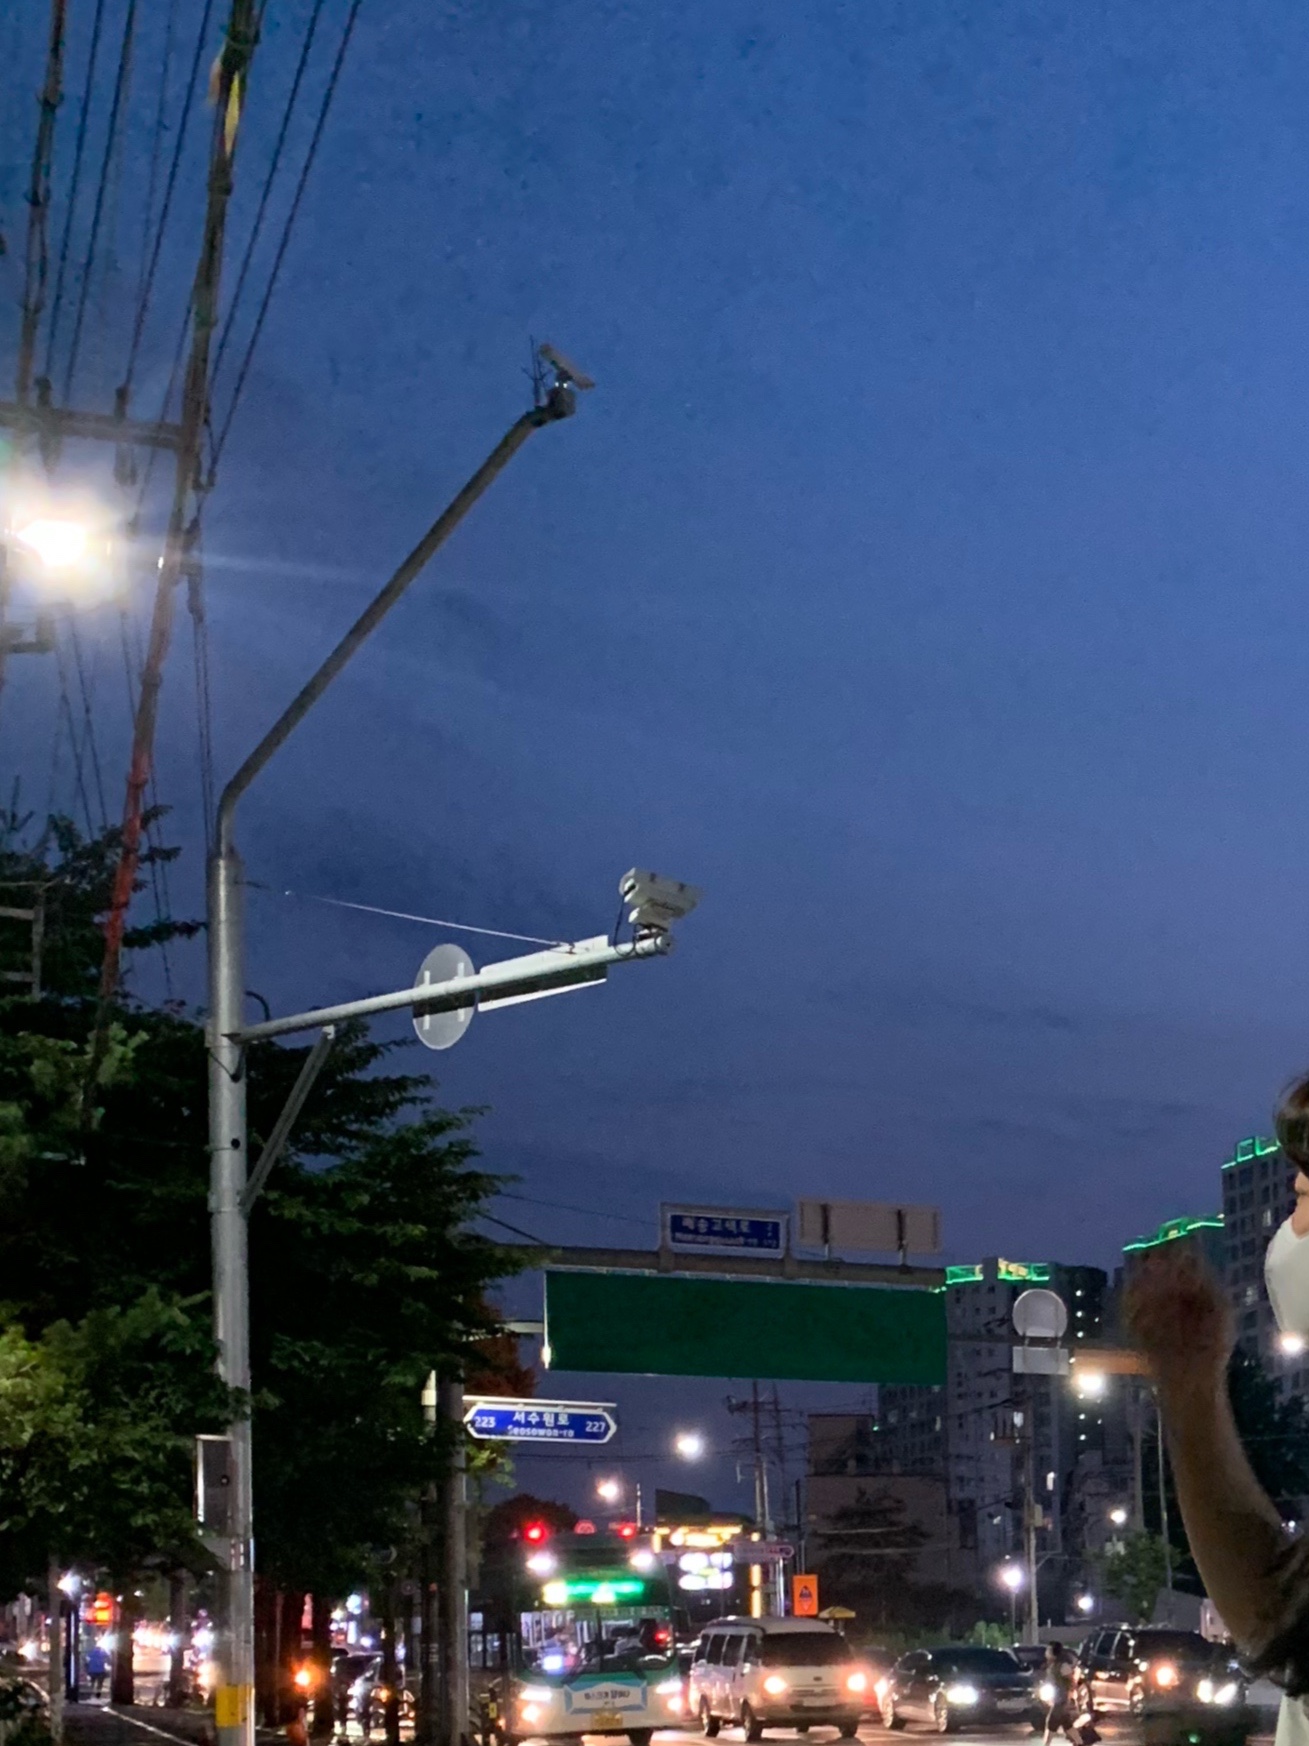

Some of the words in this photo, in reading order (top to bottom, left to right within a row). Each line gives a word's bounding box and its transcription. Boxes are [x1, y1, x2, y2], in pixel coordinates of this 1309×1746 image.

[474, 1416, 496, 1428] 223
[513, 1411, 570, 1427] 서수원로
[507, 1425, 574, 1438] Seosowon-ro
[585, 1421, 606, 1433] 227
